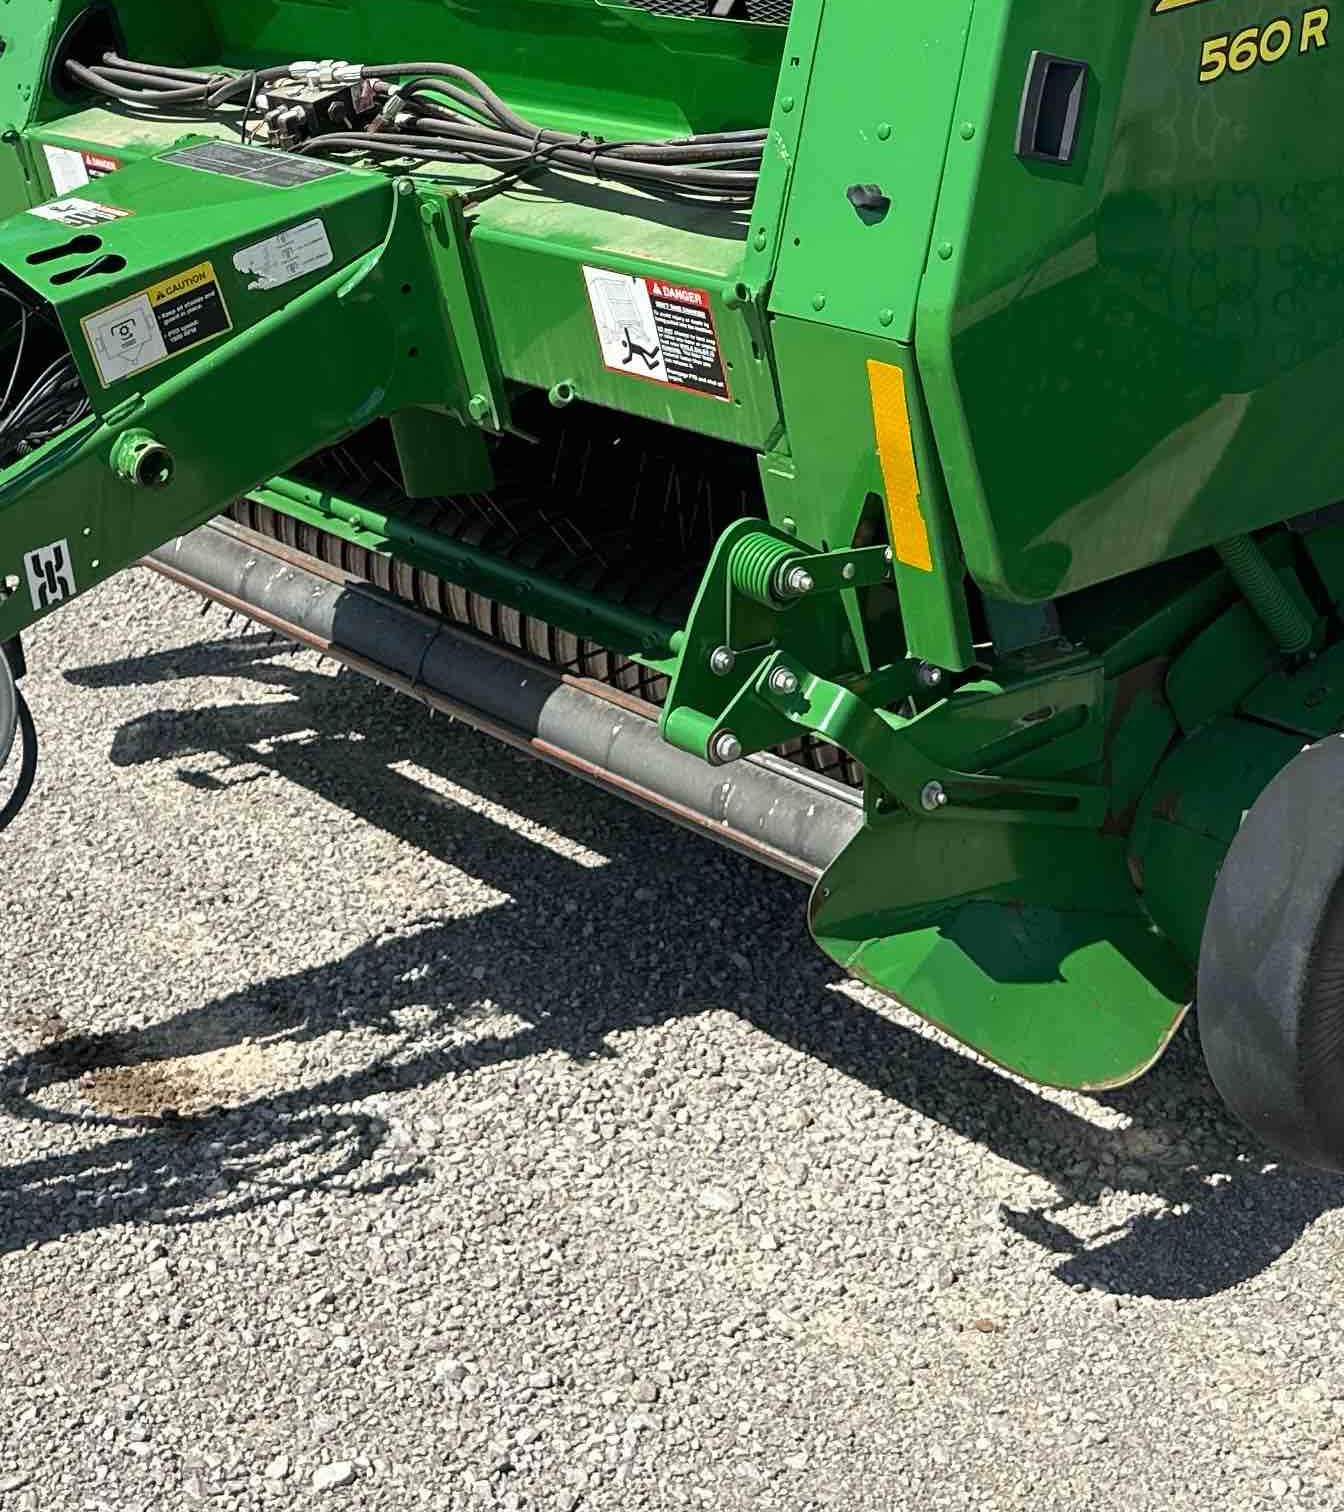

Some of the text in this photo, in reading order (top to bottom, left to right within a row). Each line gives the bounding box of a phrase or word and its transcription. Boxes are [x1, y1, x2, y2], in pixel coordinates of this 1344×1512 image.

[1199, 7, 1330, 83] 560 R
[165, 272, 206, 295] CAUTION
[662, 285, 702, 304] DANGER
